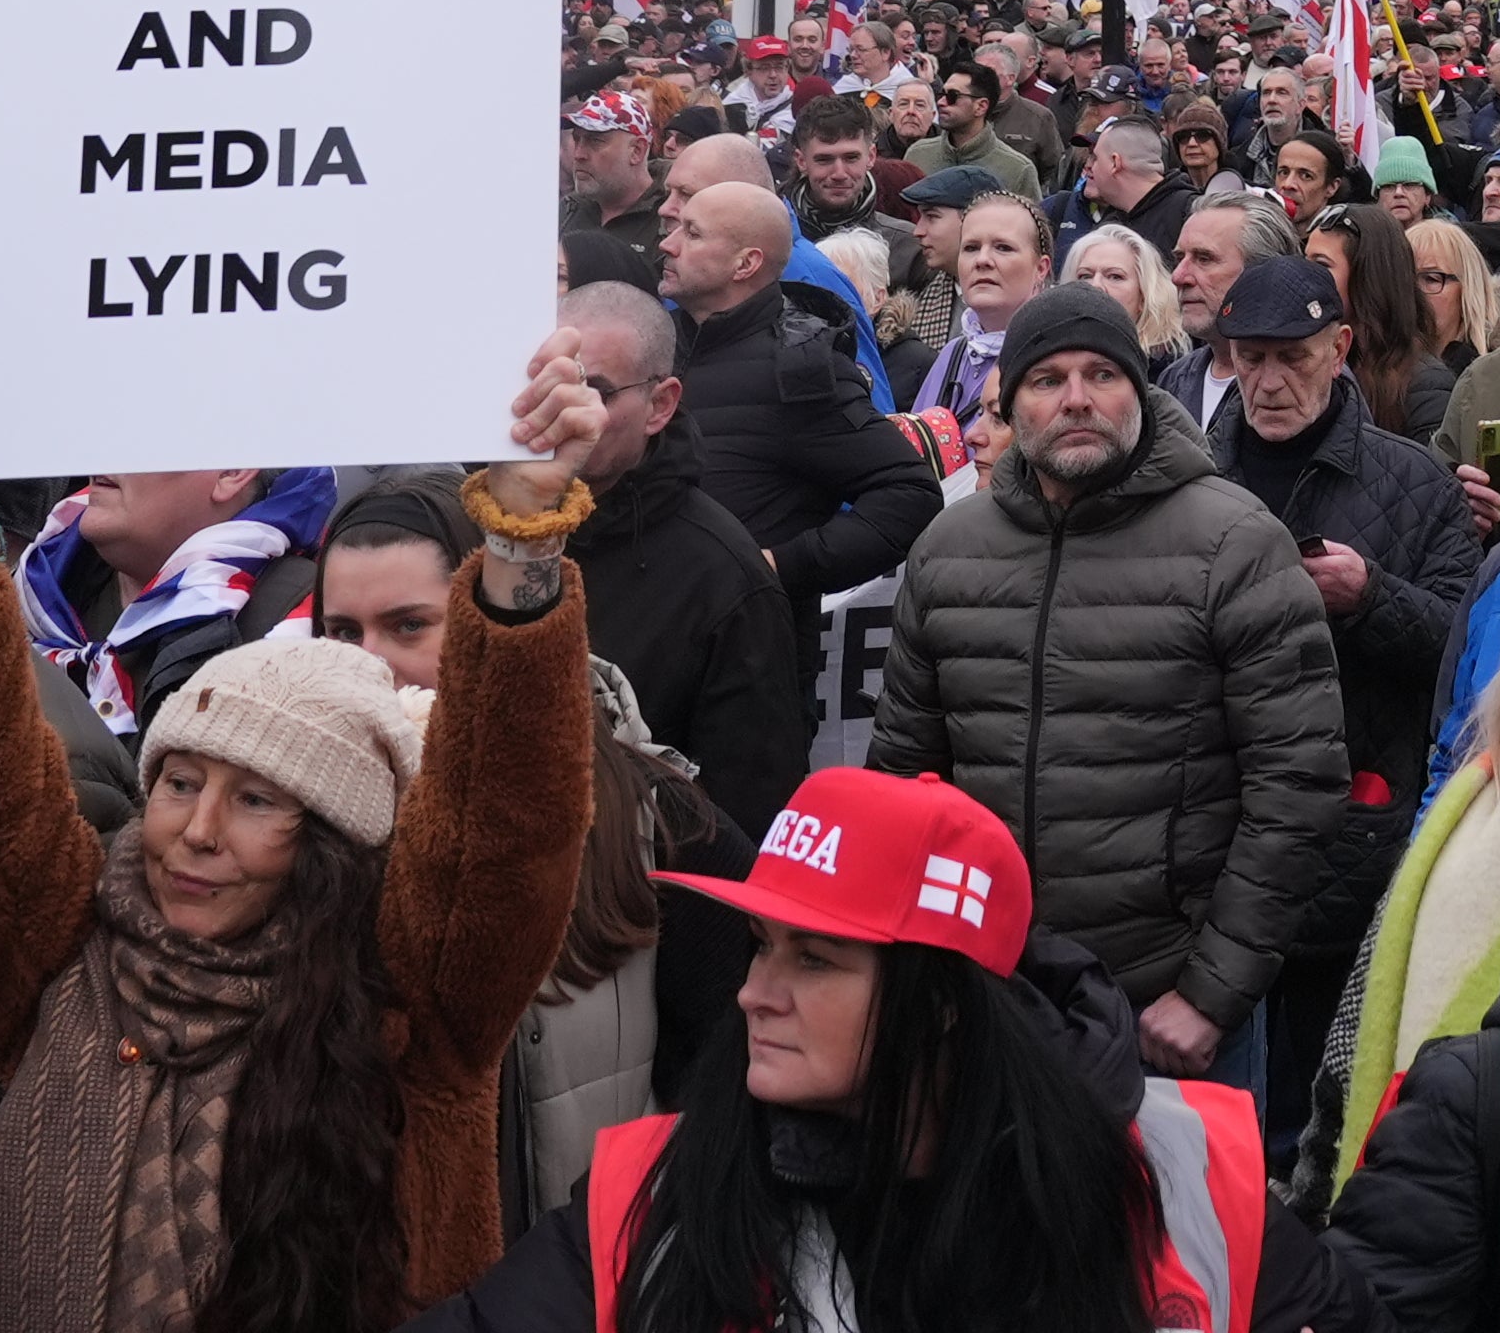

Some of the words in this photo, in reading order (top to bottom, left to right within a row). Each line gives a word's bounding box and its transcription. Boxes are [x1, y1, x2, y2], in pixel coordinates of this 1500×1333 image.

[117, 9, 311, 70] AND
[80, 127, 366, 194] MEDIA
[88, 250, 346, 318] LYING
